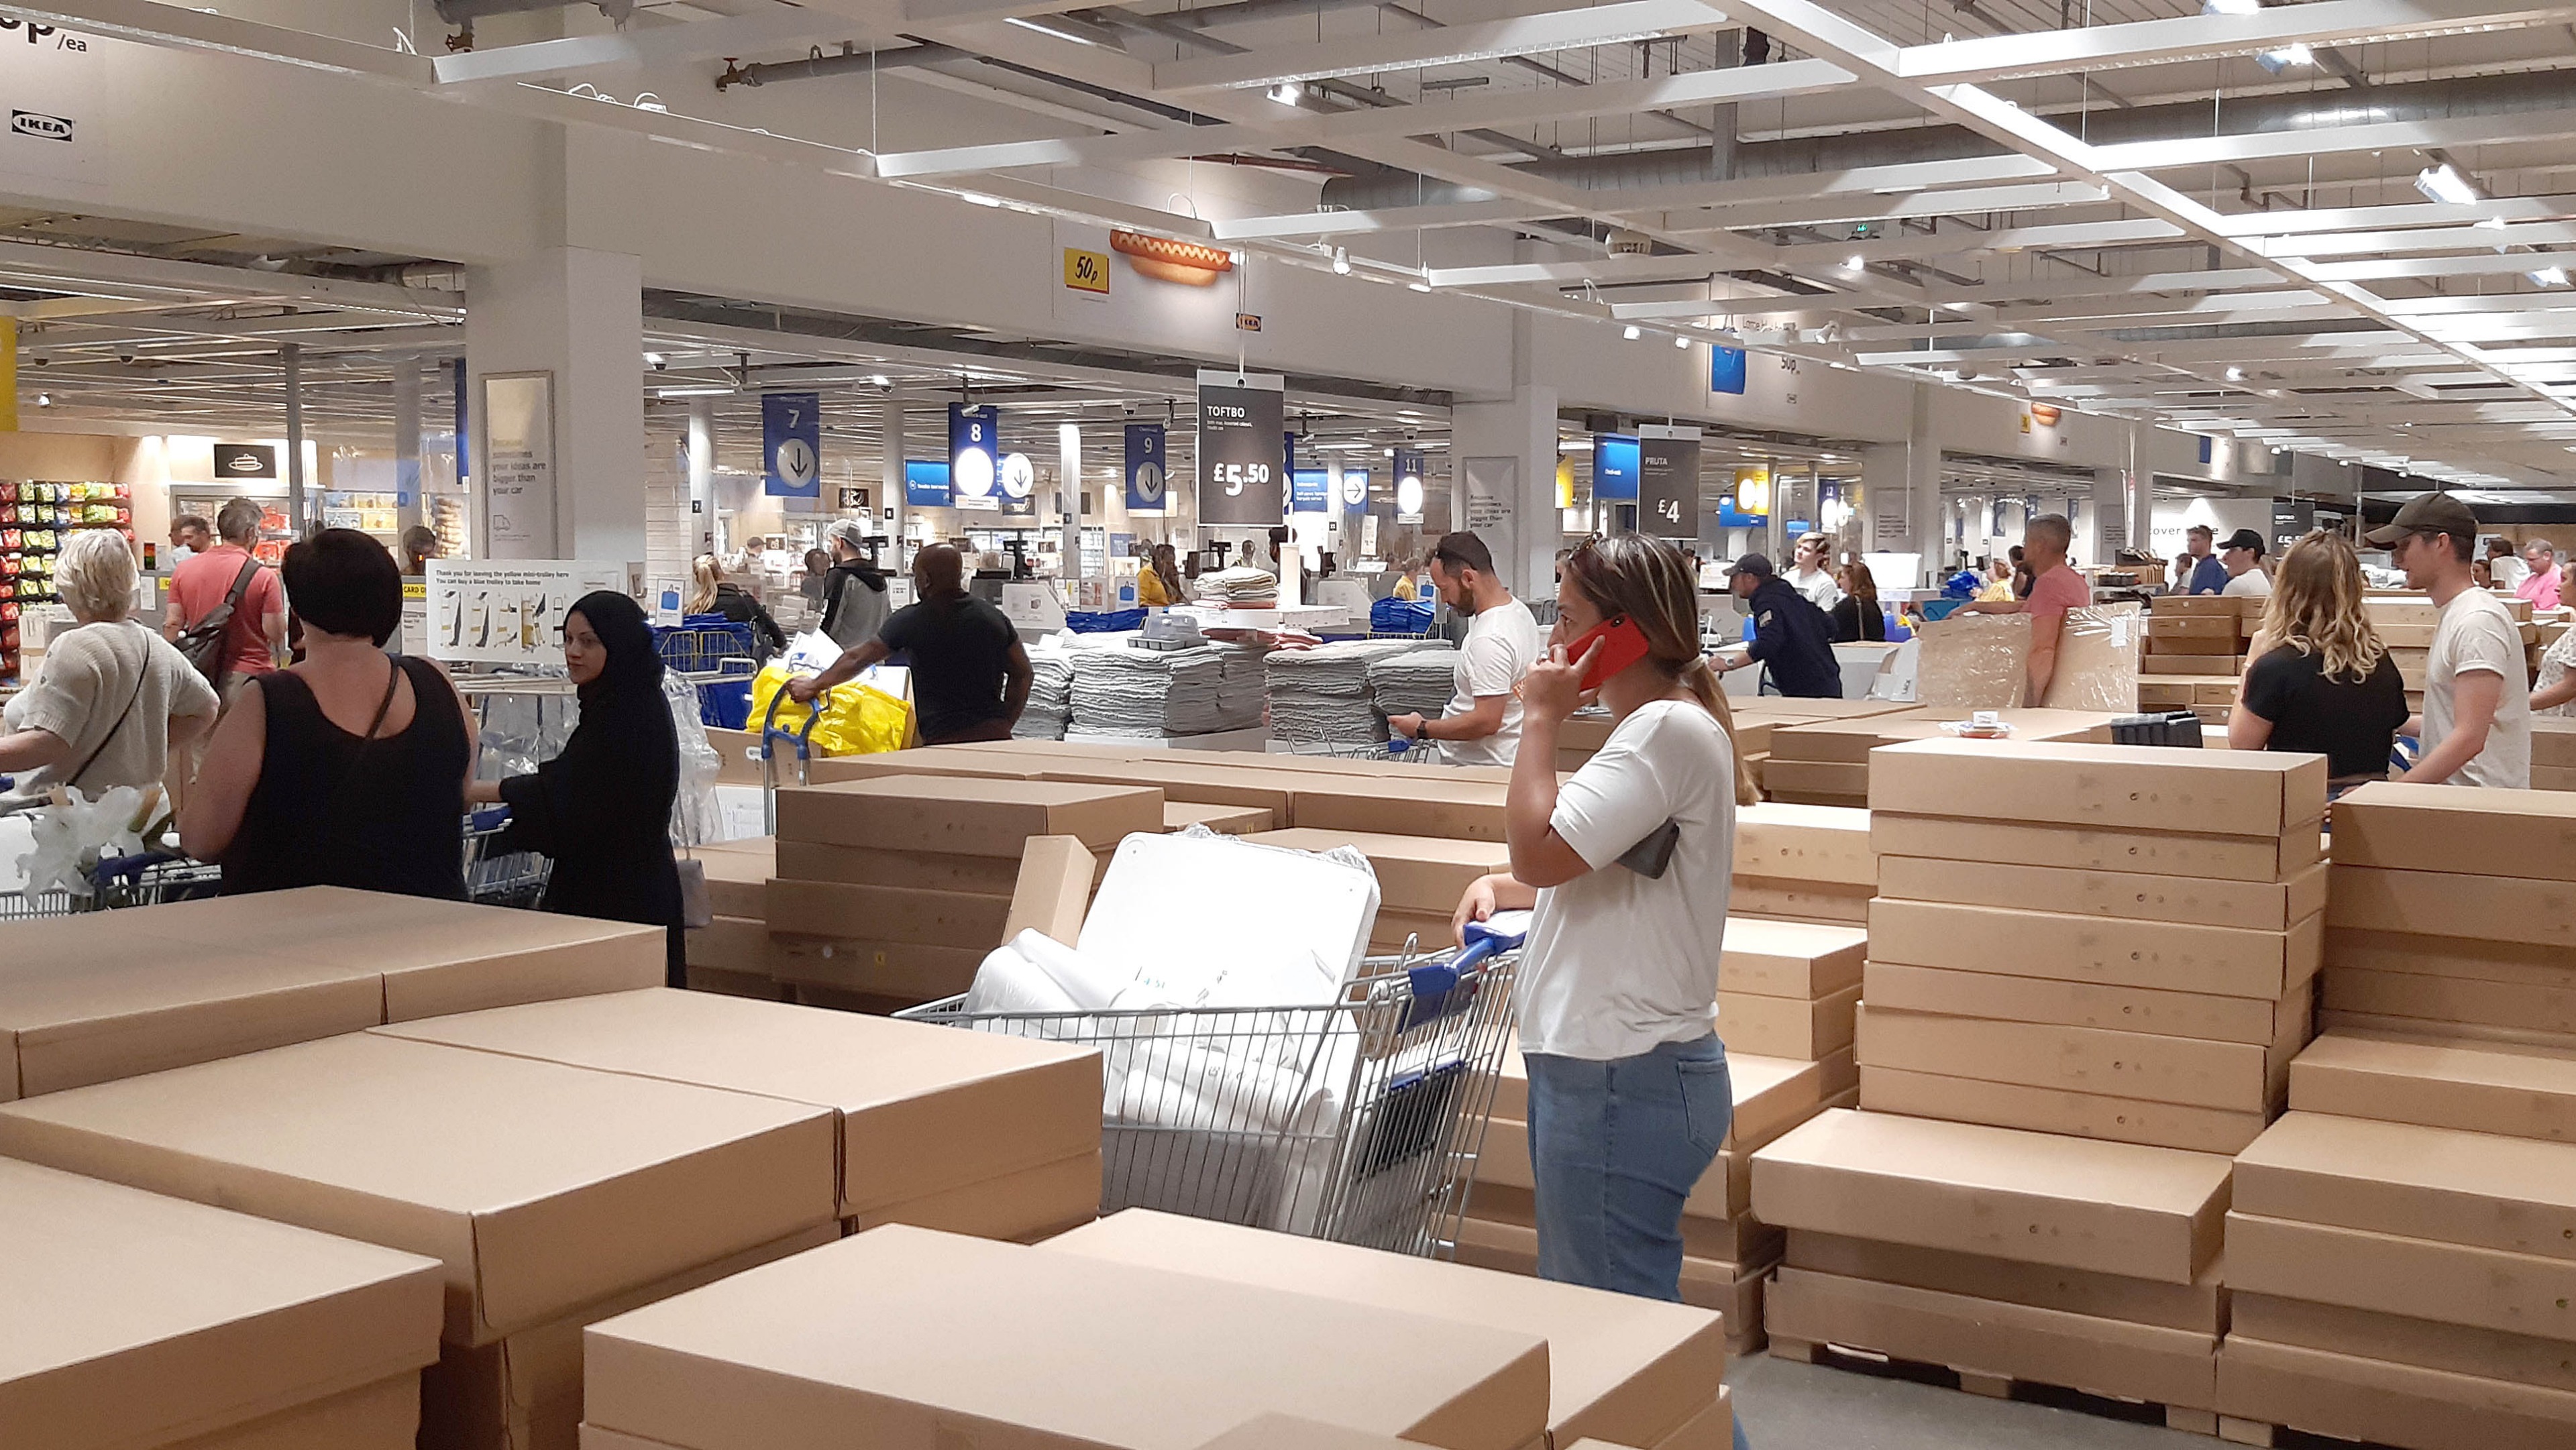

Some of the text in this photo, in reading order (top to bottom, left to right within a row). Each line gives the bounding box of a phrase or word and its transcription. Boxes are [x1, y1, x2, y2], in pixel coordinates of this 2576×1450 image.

[20, 117, 66, 134] IKEA
[1075, 256, 1098, 284] 50p
[788, 409, 800, 429] 7
[1207, 405, 1245, 417] TOFTBO
[971, 423, 982, 442] 8
[1144, 437, 1153, 454] 9
[533, 462, 547, 470] are
[1405, 458, 1417, 472] 11
[1645, 457, 1668, 465] PRUTA
[1213, 463, 1270, 496] £5.50
[1658, 499, 1680, 523] £4
[404, 585, 420, 594] CARD
